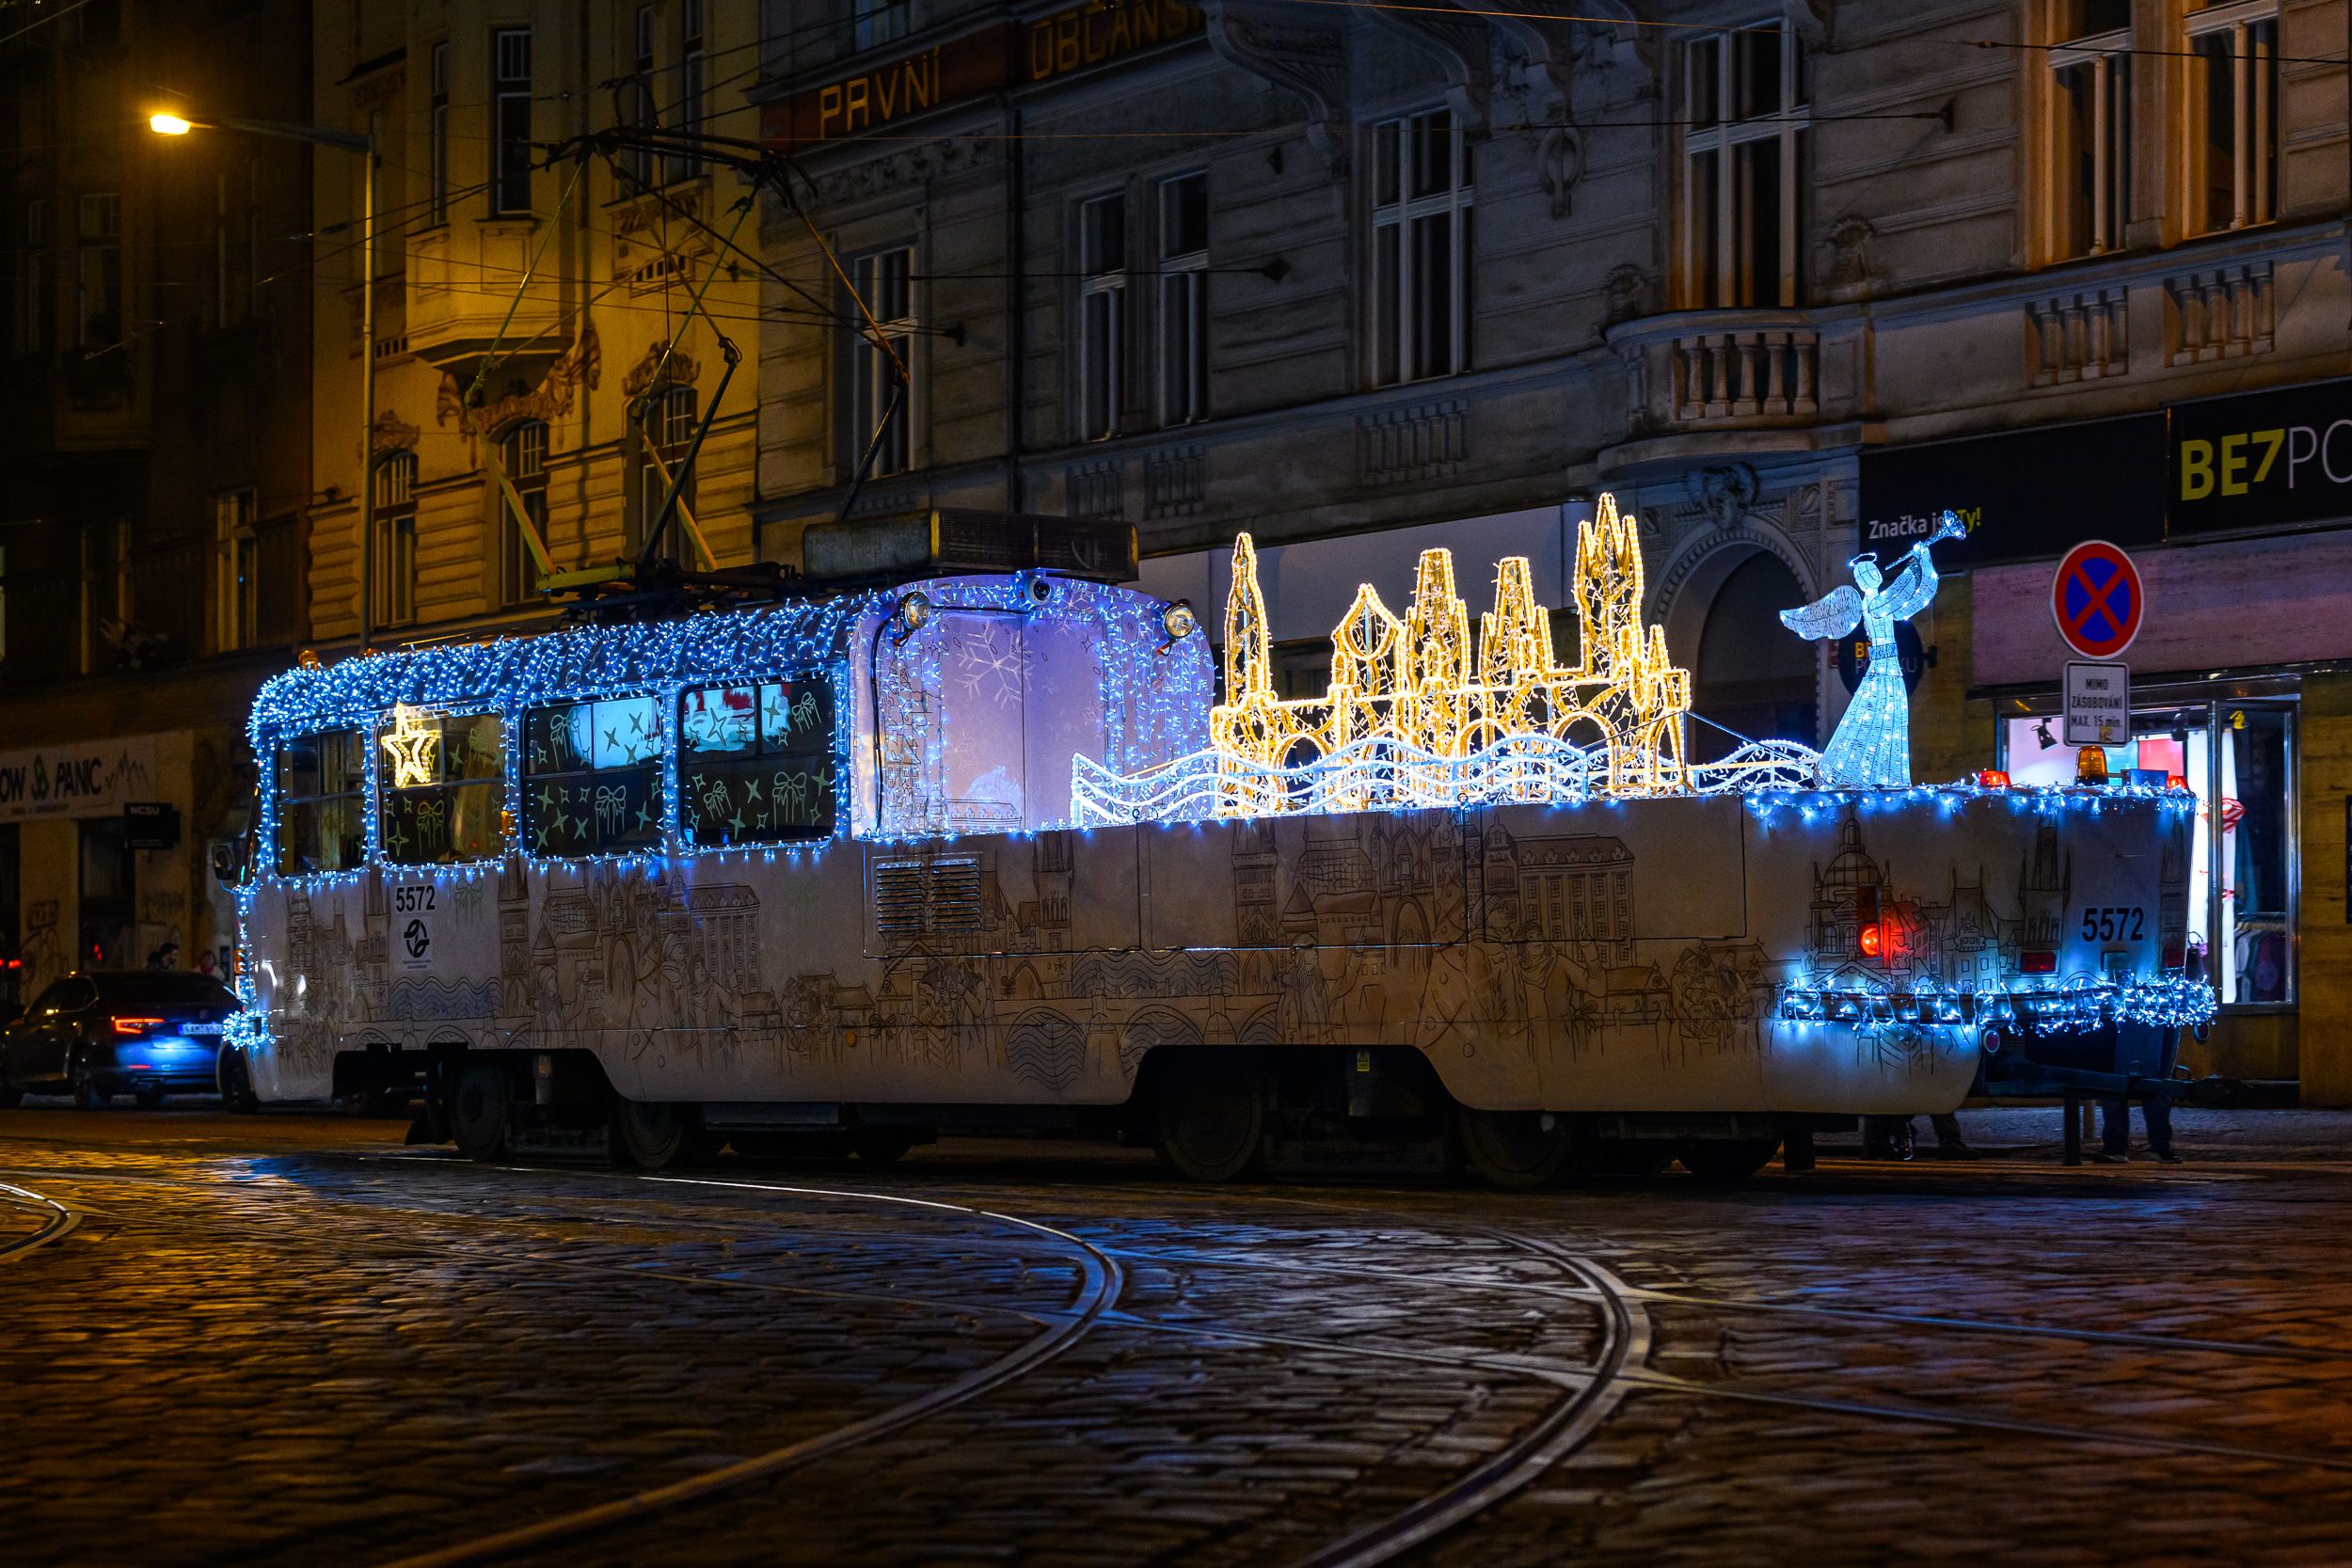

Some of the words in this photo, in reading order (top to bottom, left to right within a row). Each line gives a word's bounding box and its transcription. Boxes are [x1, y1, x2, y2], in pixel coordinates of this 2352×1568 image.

[1868, 515, 1927, 539] Značka
[1956, 505, 1983, 533] Ty!
[2086, 678, 2109, 690] MIMO
[2072, 693, 2123, 709] ZÁSOBOVÁNÍ
[2071, 715, 2091, 727] MAX.
[2093, 715, 2104, 727] 15
[55, 757, 102, 799] PANIC
[396, 885, 436, 912] 5572
[2082, 907, 2144, 942] 5572
